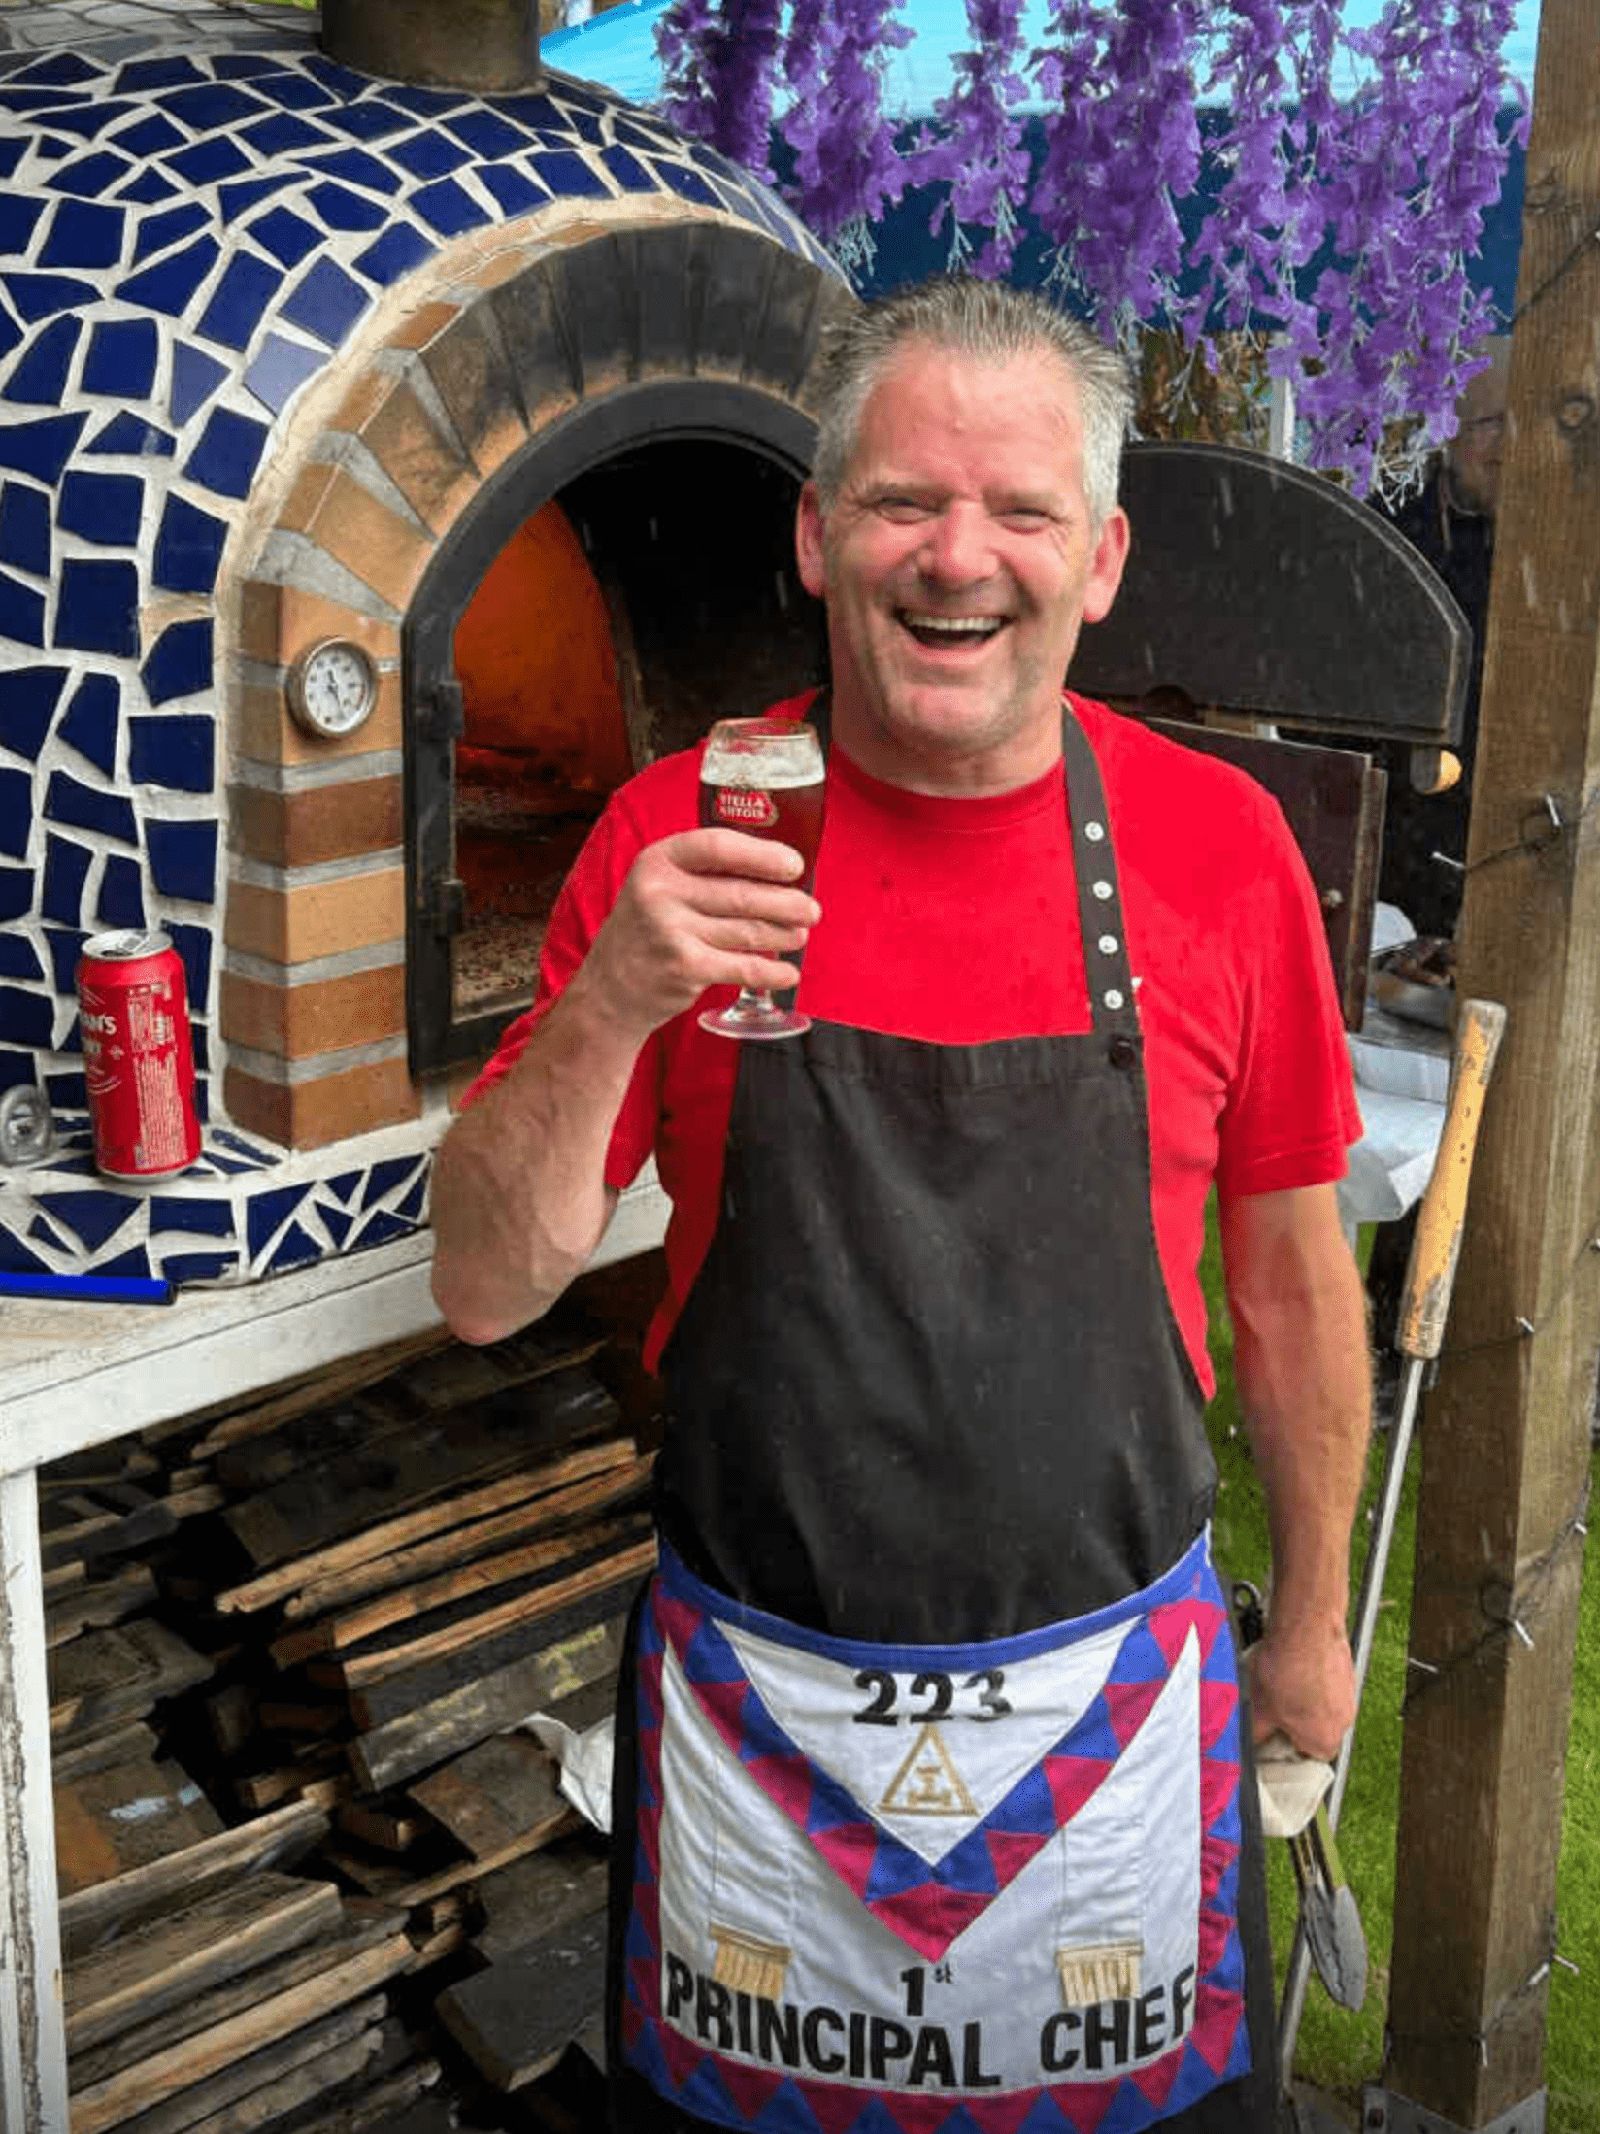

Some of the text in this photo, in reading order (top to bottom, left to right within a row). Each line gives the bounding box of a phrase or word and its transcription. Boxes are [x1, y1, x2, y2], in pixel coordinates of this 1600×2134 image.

[853, 1669, 1012, 1726] 223
[665, 1951, 1195, 2088] PRINCIPAL CHEF
[900, 1965, 953, 2017] 1st
